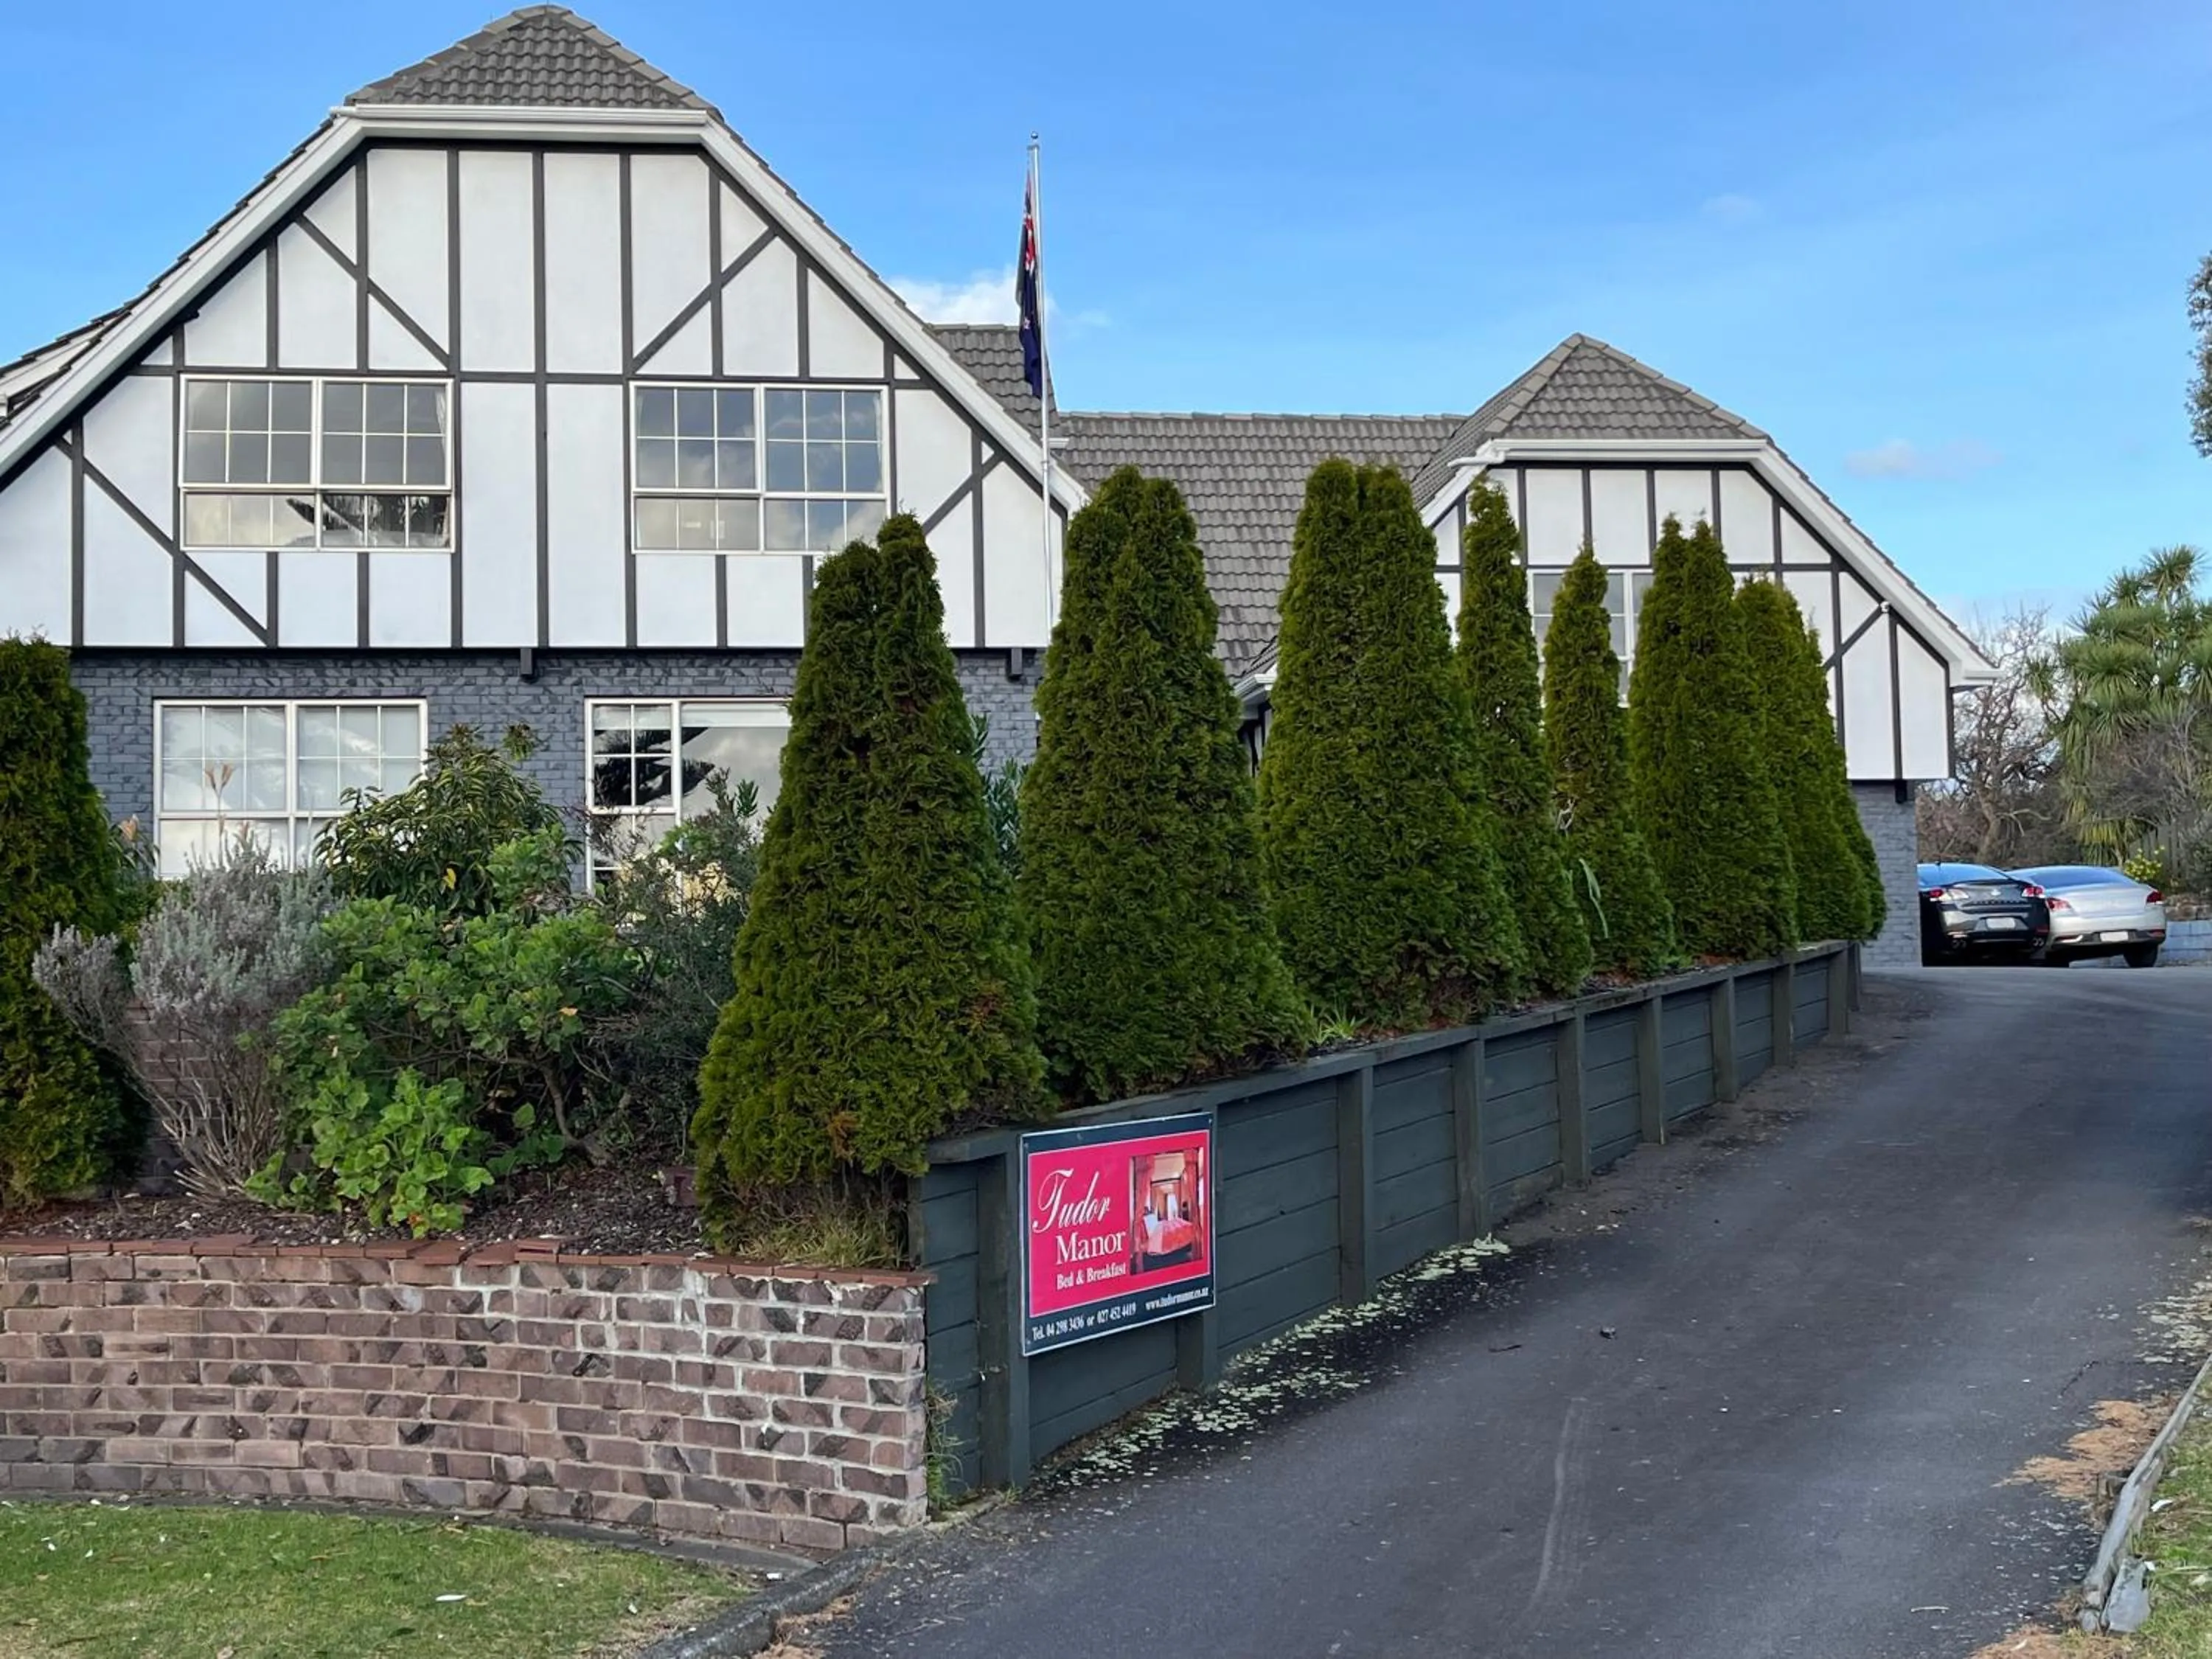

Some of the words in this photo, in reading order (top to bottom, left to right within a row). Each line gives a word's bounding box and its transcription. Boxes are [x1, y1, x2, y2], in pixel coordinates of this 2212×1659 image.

[1032, 1168, 1110, 1234] Tudor
[1056, 1231, 1126, 1265] Manor
[1057, 1270, 1074, 1290] Bed
[1076, 1269, 1085, 1285] &
[1086, 1262, 1127, 1284] Breakfast
[1046, 1323, 1055, 1337] 04
[1086, 1315, 1095, 1327] or
[1096, 1308, 1109, 1324] 027
